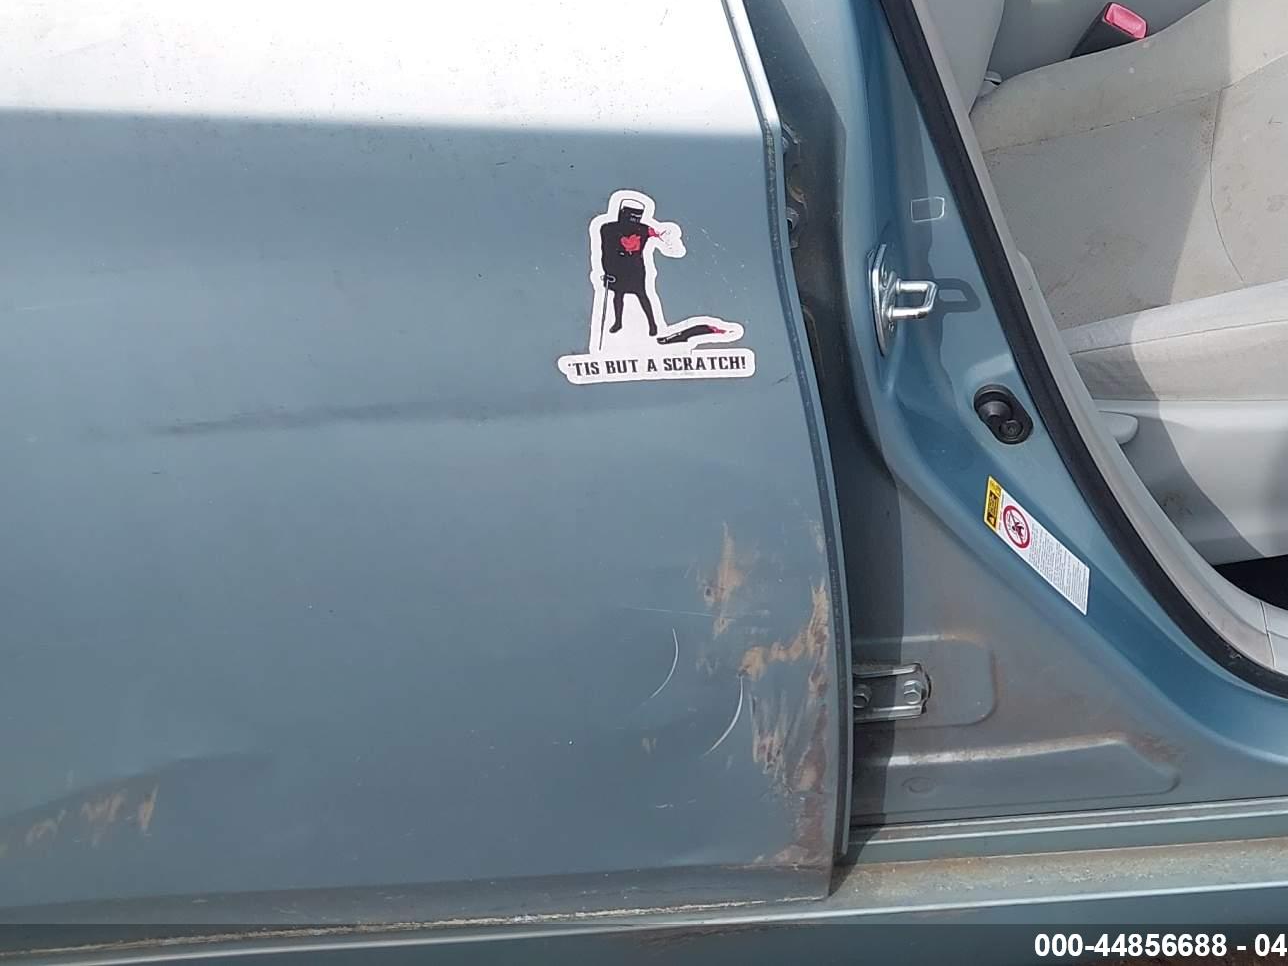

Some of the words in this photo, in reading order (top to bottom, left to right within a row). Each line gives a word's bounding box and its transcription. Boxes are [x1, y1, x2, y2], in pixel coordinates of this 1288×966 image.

[606, 359, 638, 374] BUT
[647, 357, 657, 372] A
[663, 355, 747, 370] SCRATCH!
